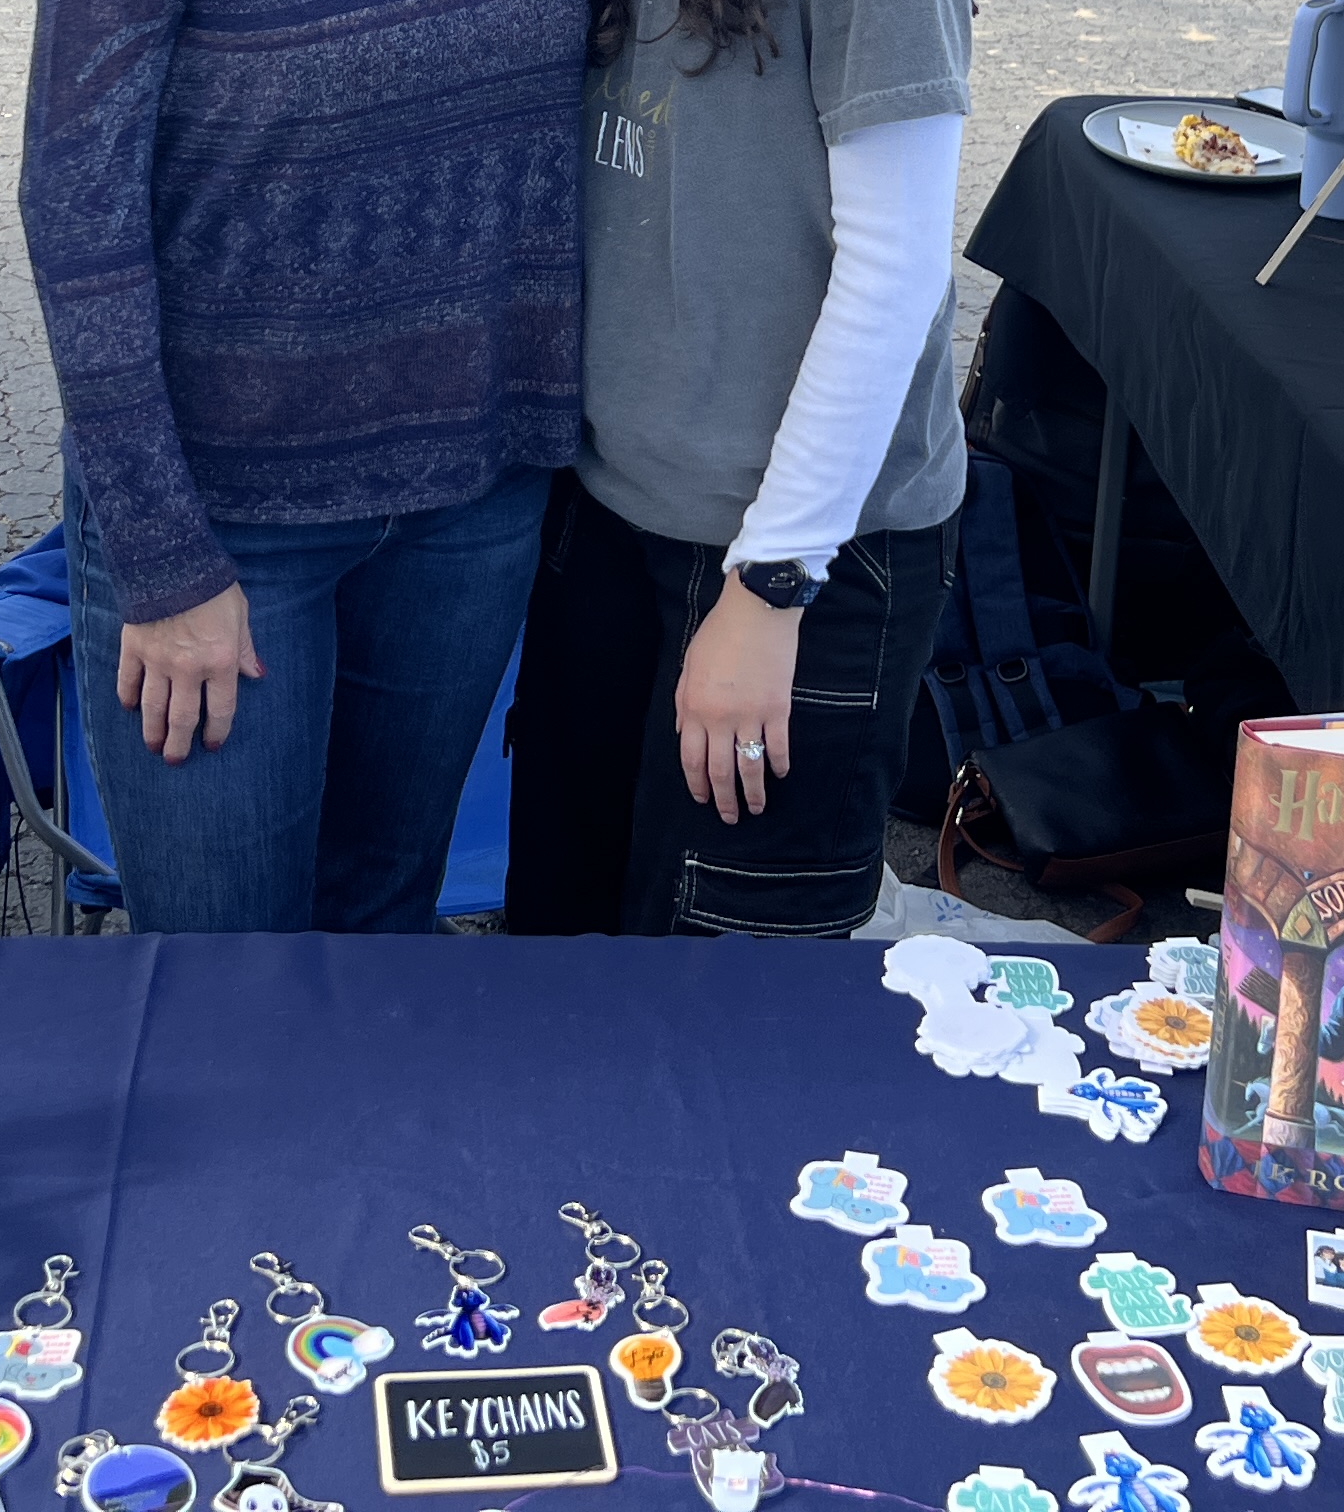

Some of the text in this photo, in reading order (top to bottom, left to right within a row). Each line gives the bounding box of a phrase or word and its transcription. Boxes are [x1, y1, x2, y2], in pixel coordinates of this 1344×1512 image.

[595, 110, 644, 178] LENS
[1102, 1268, 1155, 1291] CATS
[1111, 1288, 1165, 1309] CATS
[1122, 1307, 1175, 1326] CATS
[406, 1389, 586, 1441] KEYCHAINS
[686, 1420, 743, 1447] CATS
[469, 1439, 511, 1472] $5
